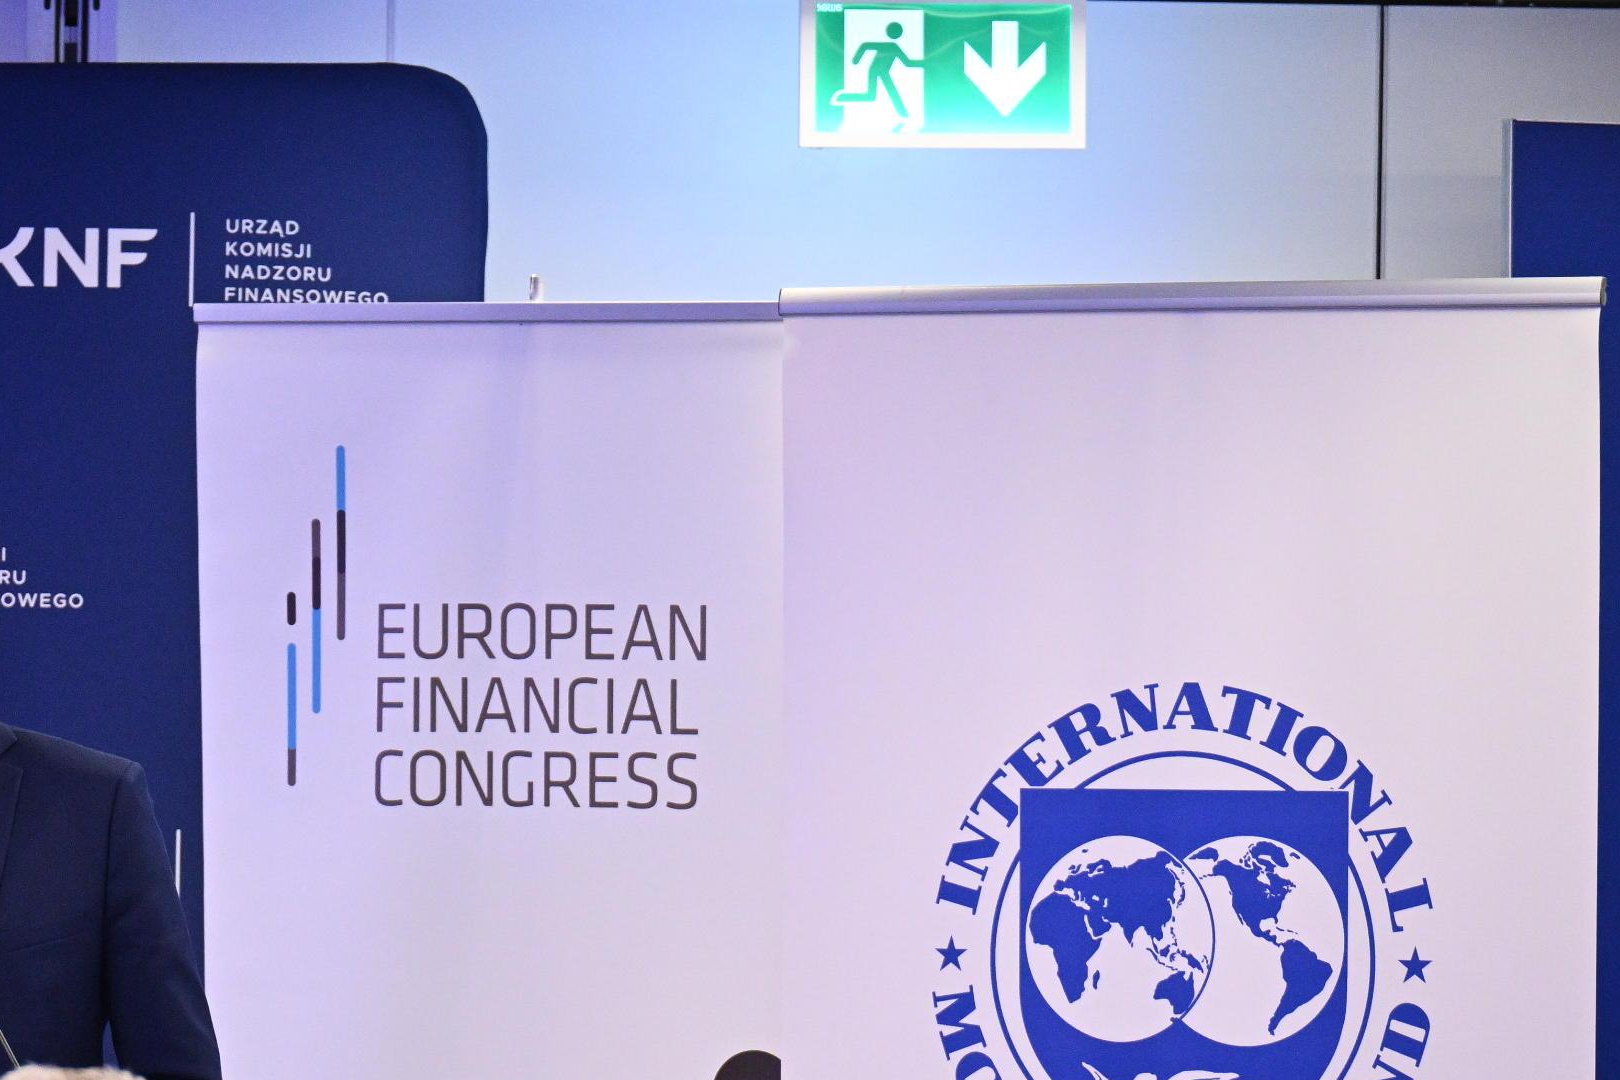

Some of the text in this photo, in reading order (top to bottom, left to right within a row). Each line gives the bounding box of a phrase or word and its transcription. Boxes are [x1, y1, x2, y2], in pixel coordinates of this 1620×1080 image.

[225, 241, 312, 259] KOMISJI
[226, 218, 300, 238] URZĄD
[225, 264, 332, 282] NADZORU
[377, 602, 707, 661] EUROPEAN
[376, 676, 699, 736] FINANCIAL
[374, 749, 698, 810] CONGRESS
[935, 682, 1433, 932] INTERNATIONAL
